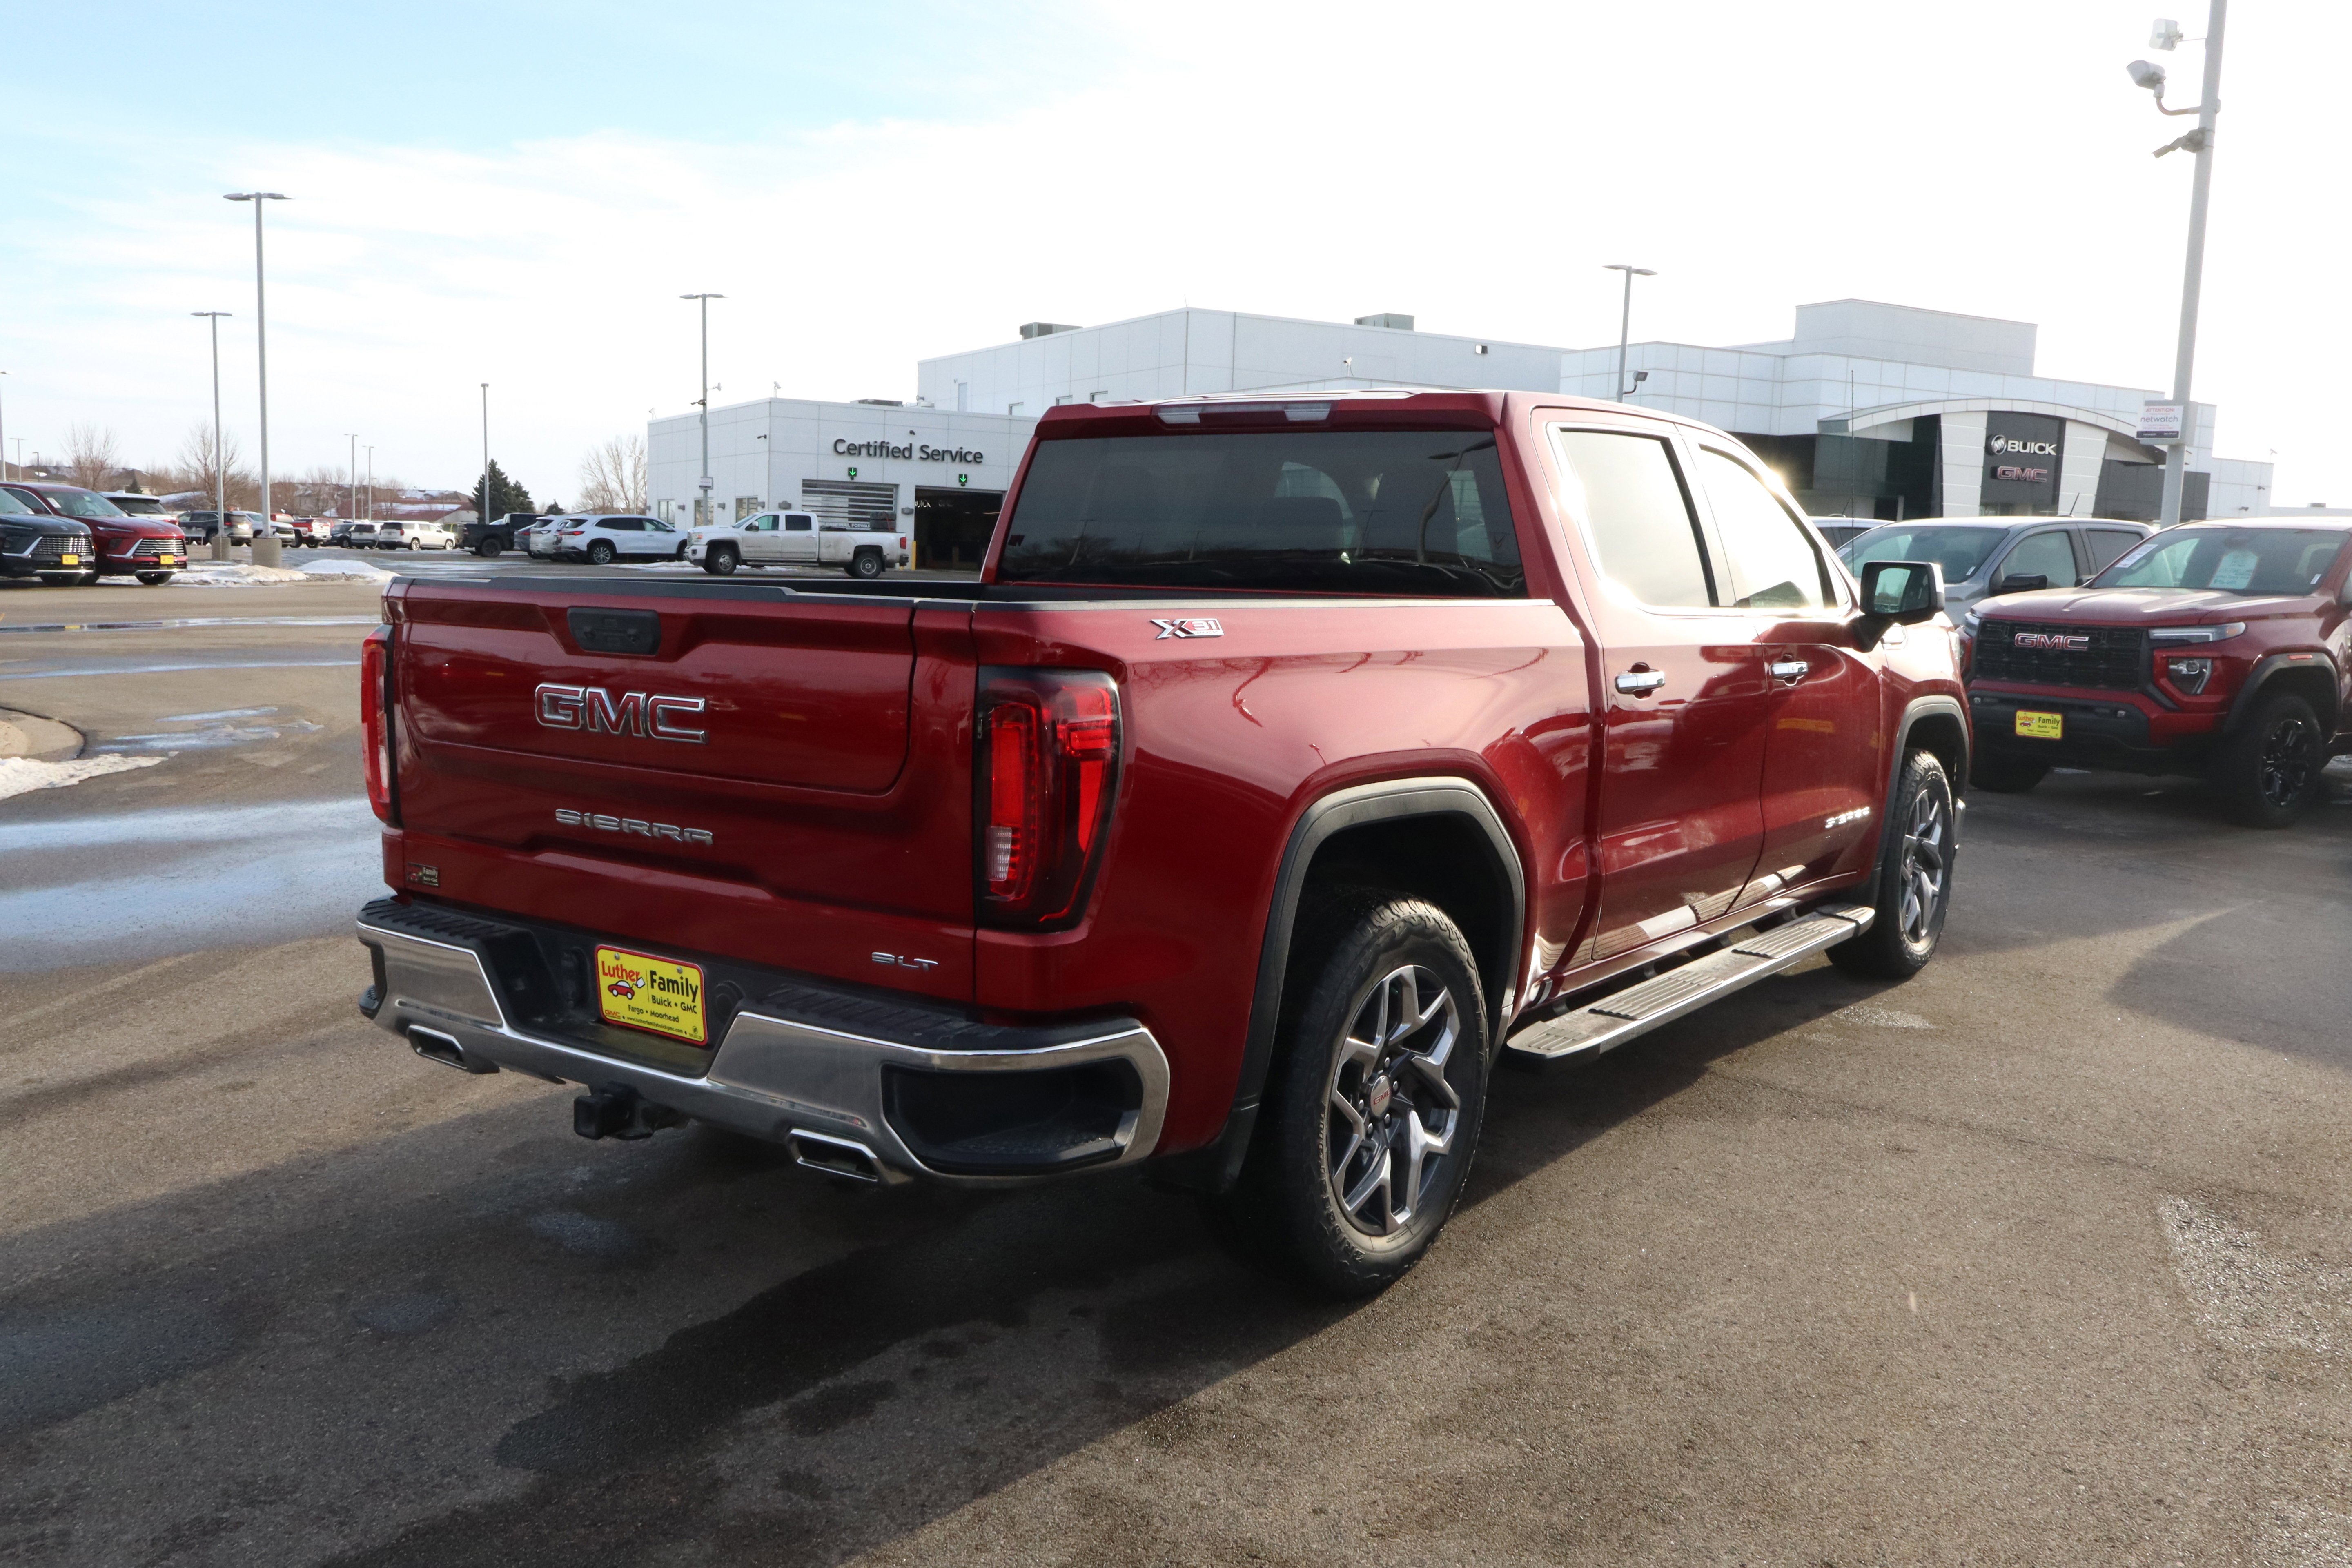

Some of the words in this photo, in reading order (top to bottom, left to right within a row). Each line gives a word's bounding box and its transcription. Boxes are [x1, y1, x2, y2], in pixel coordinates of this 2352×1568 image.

[833, 439, 913, 459] Certified
[919, 445, 983, 464] Service
[2007, 440, 2057, 455] BUICK
[1997, 466, 2047, 482] GMC
[2015, 633, 2089, 651] GMC
[535, 682, 706, 744] GMC
[2038, 717, 2060, 726] Family
[555, 808, 713, 845] SIERRA
[871, 952, 939, 971] SLT
[601, 961, 640, 982] Luther
[650, 970, 698, 1003] Family
[605, 1010, 621, 1018] GMC
[628, 1004, 644, 1015] Fargo
[650, 1010, 679, 1023] Moorhead
[651, 995, 672, 1008] Buick
[680, 1002, 697, 1014] GMC
[1373, 1087, 1392, 1105] GMC
